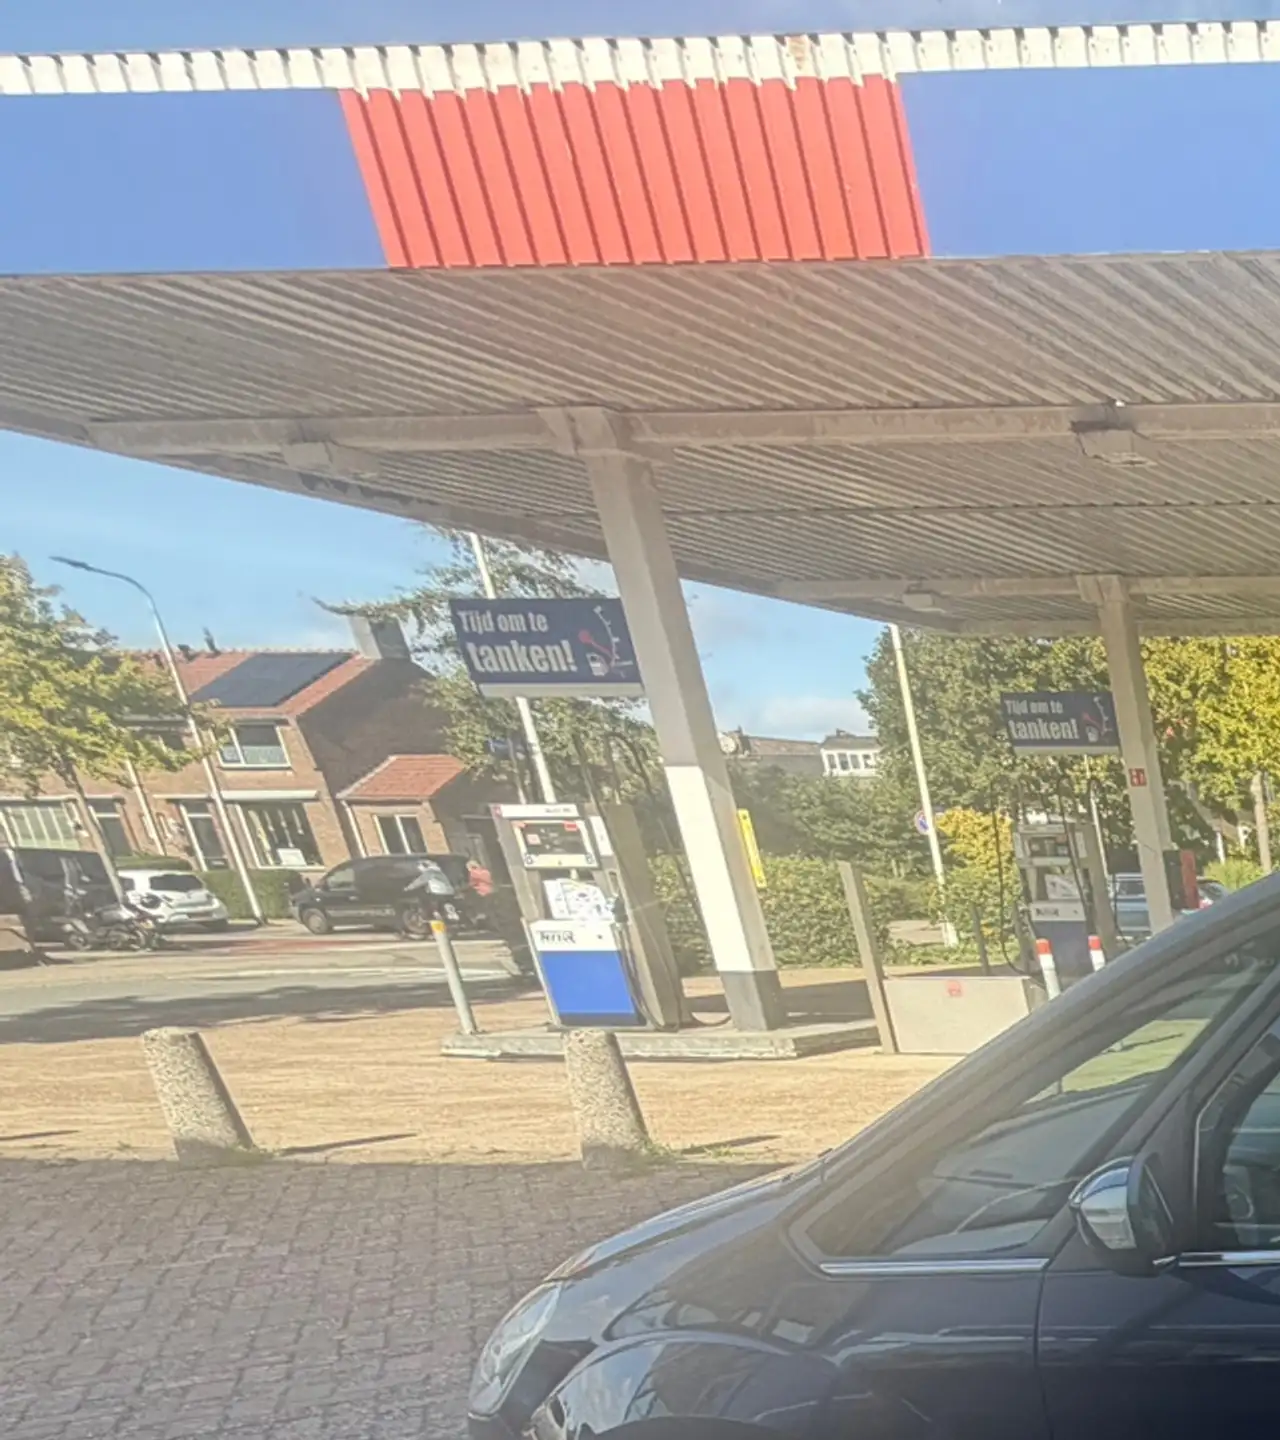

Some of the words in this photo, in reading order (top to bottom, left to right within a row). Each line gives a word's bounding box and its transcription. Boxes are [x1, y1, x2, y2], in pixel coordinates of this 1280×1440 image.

[457, 610, 494, 635] Tijd
[498, 613, 528, 632] om
[528, 611, 548, 632] te
[466, 639, 578, 673] tanken!
[1004, 699, 1028, 715] Tijd
[1030, 701, 1049, 714] om
[1050, 700, 1063, 714] te
[1008, 717, 1080, 740] tanken!
